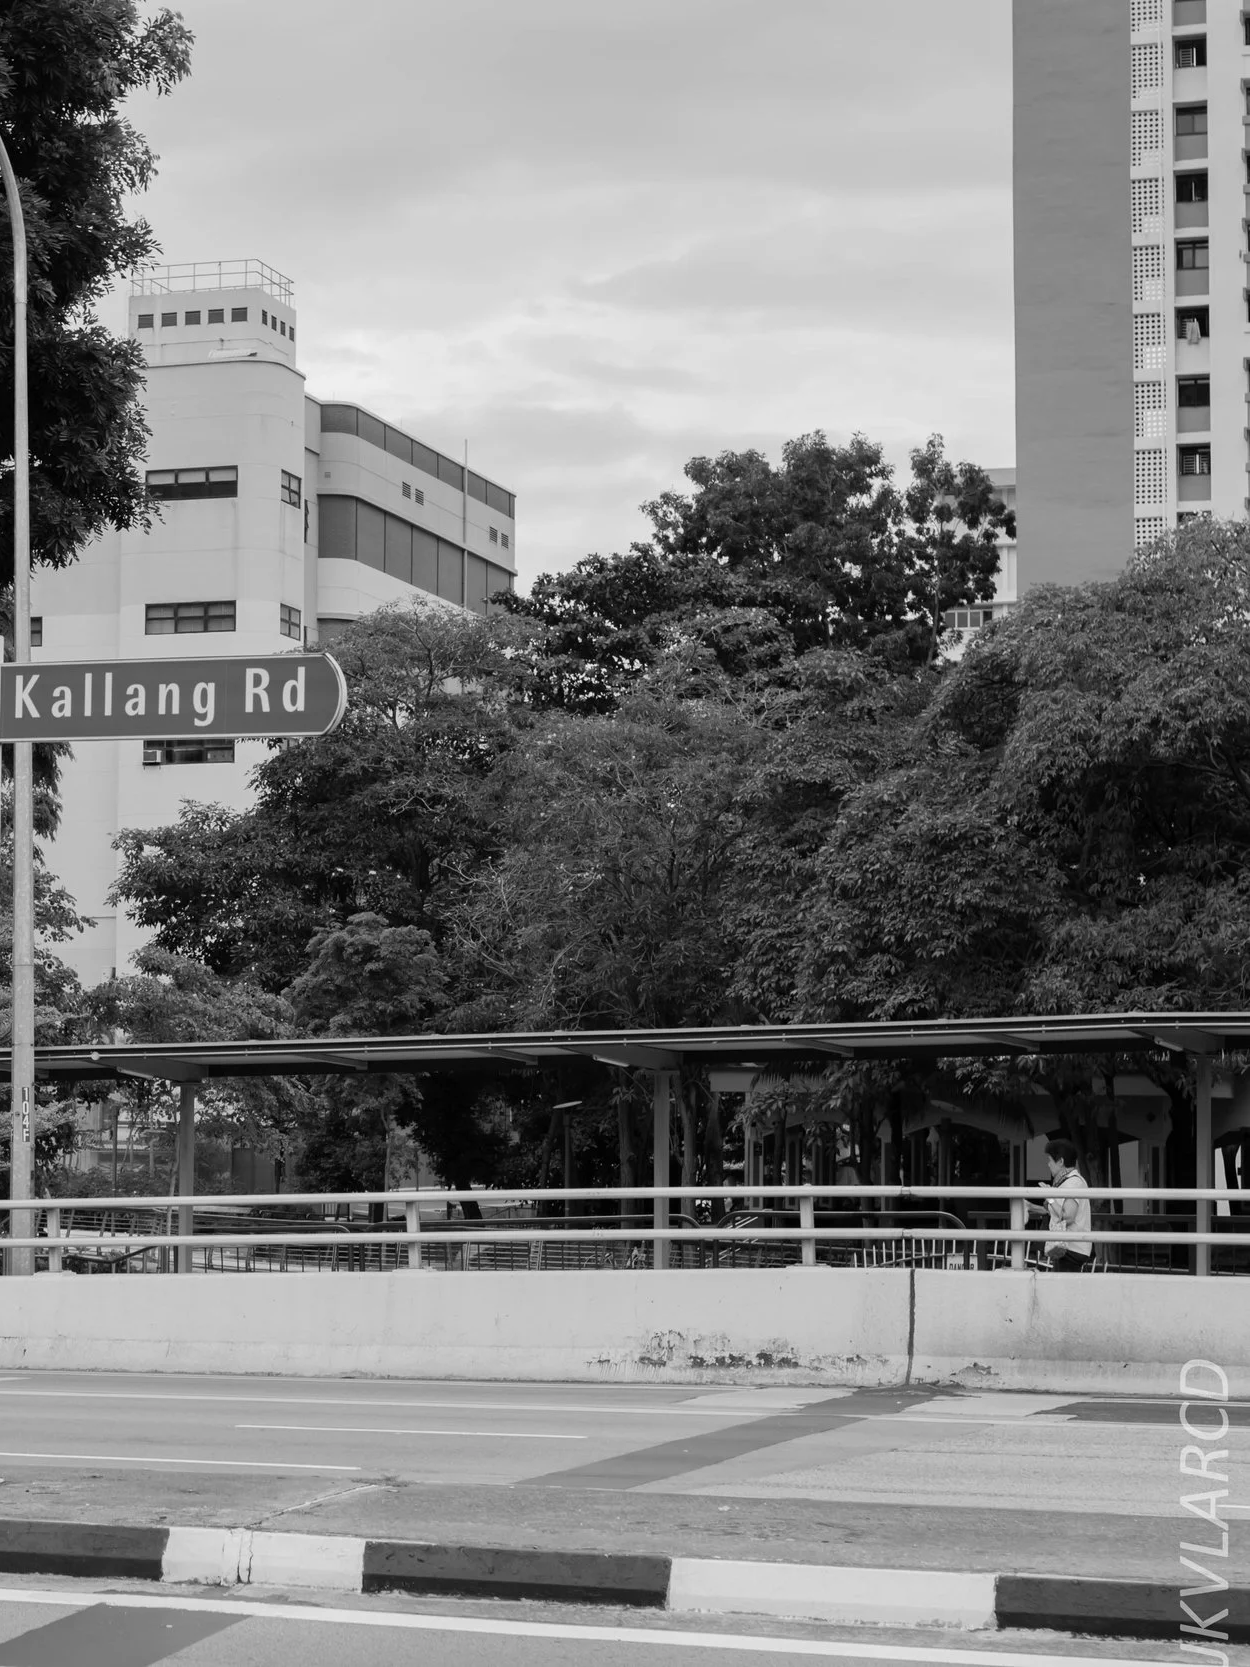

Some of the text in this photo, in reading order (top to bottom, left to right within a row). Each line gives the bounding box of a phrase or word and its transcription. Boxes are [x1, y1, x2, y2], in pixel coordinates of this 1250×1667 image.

[15, 666, 306, 727] Kallang Rd
[22, 1087, 30, 1142] 104F
